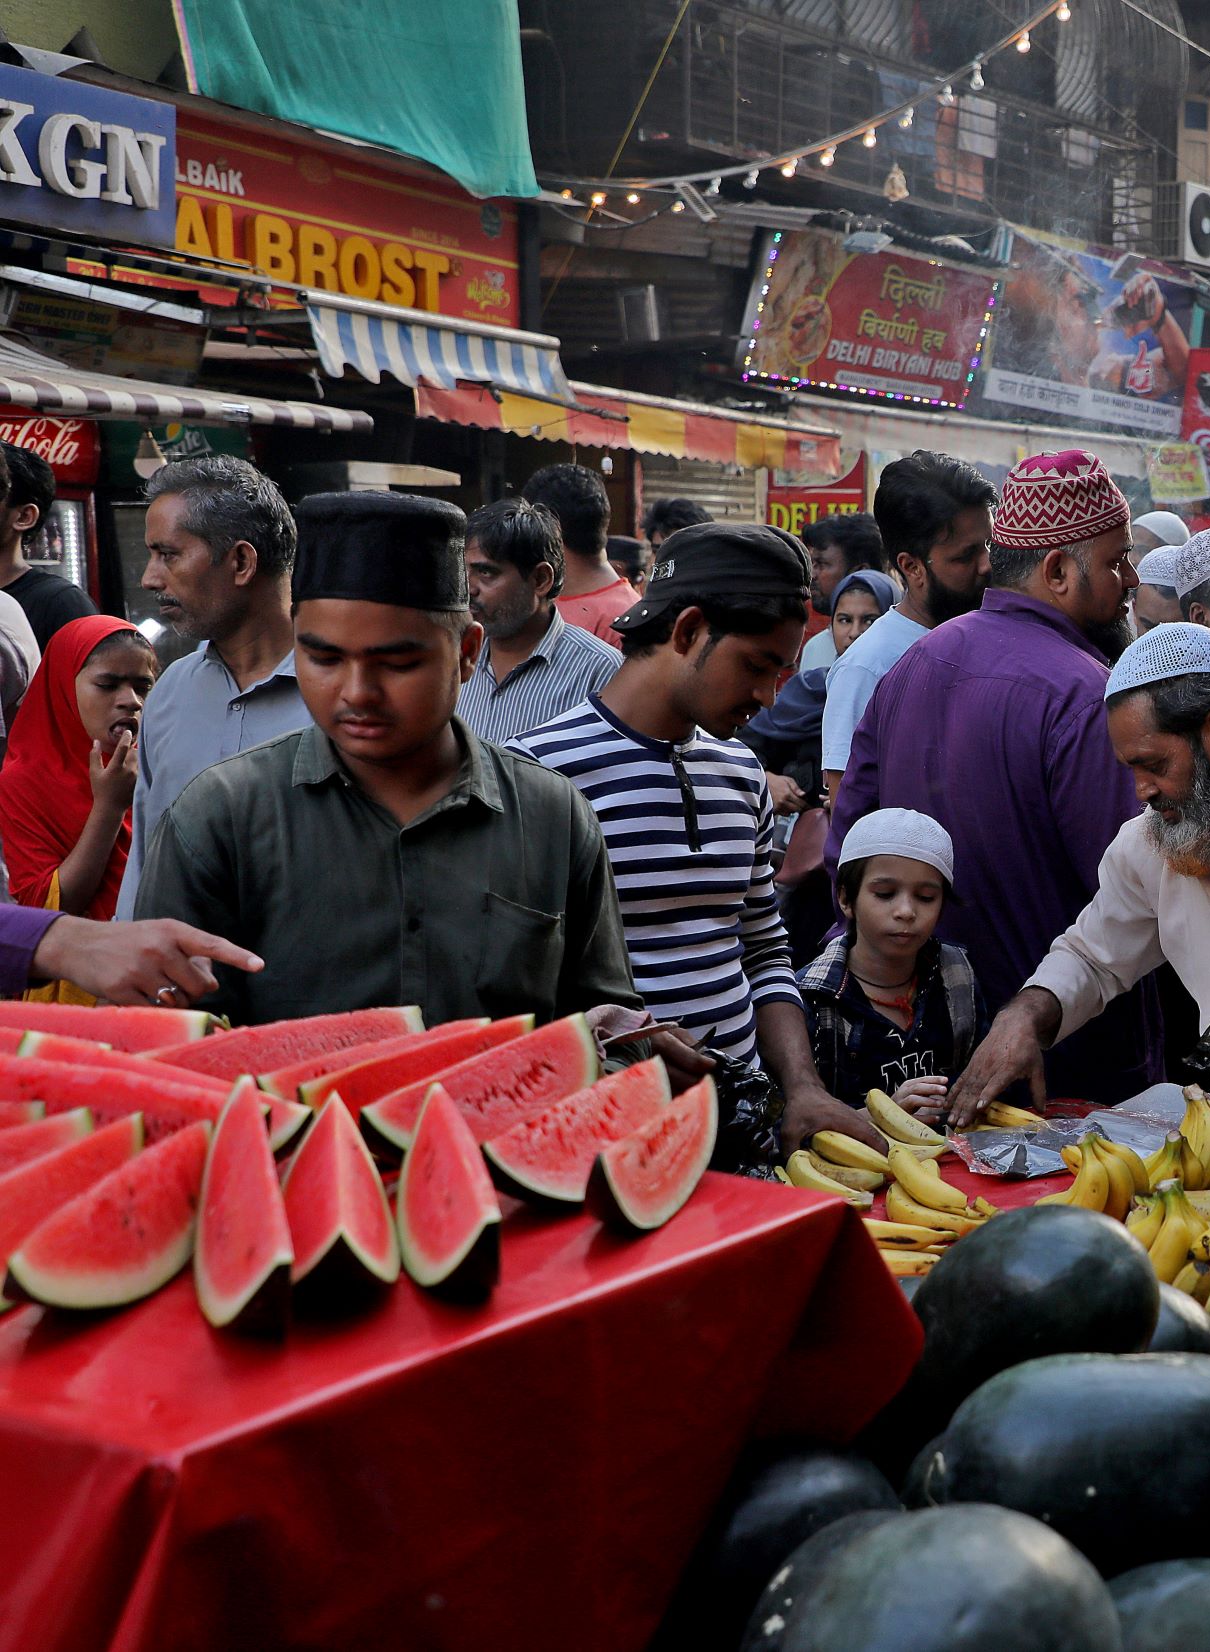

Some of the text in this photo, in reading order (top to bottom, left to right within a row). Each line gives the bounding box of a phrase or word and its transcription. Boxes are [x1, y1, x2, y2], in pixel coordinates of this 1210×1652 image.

[826, 339, 962, 381] DELHI BIRYANI HUB
